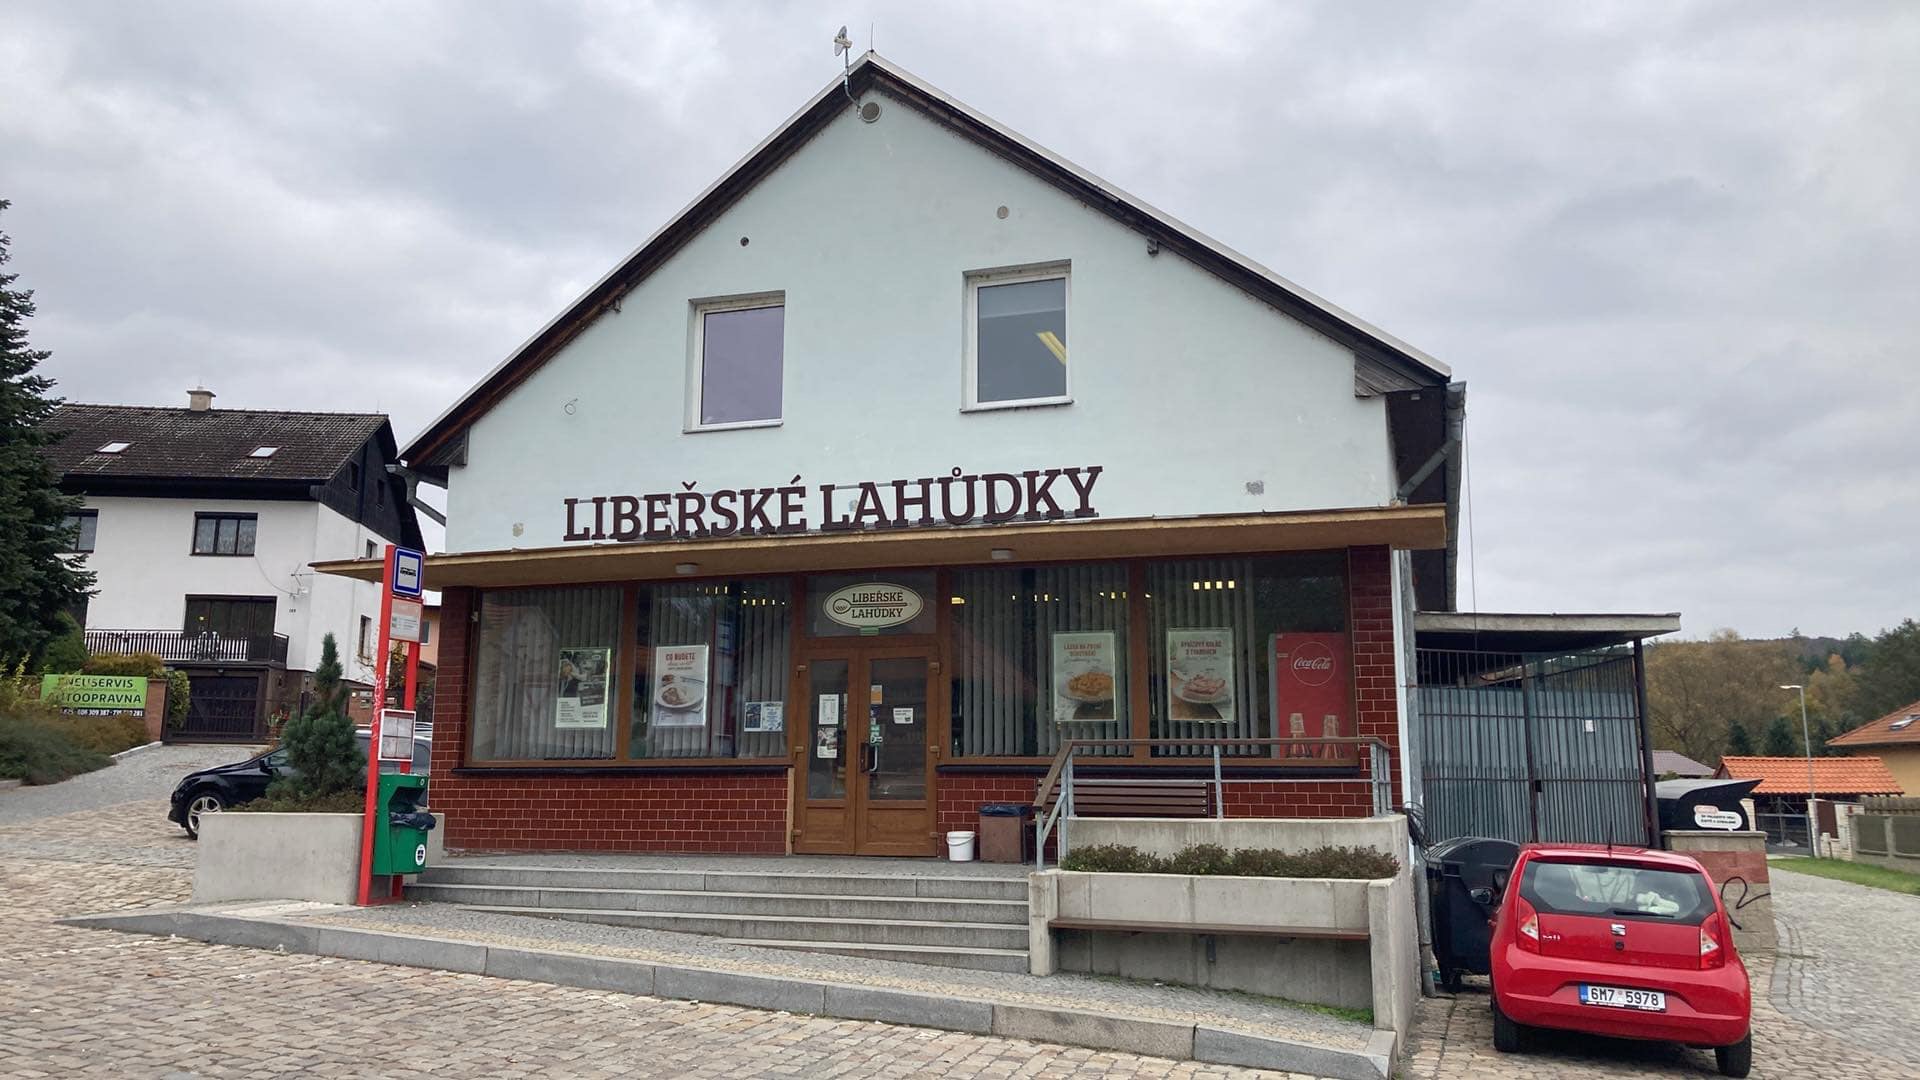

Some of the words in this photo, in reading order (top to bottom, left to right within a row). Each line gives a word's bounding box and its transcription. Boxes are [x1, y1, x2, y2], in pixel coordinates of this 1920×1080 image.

[563, 475, 807, 542] LIBEŘSKÉ
[819, 466, 1103, 531] LAHŮDKY
[852, 590, 904, 603] LIBEŘSKÉ
[851, 607, 904, 619] LAHŮDKY
[1294, 657, 1331, 670] Coca-Cola
[1591, 987, 1615, 1002] 6M7
[1625, 991, 1659, 1006] 5978
